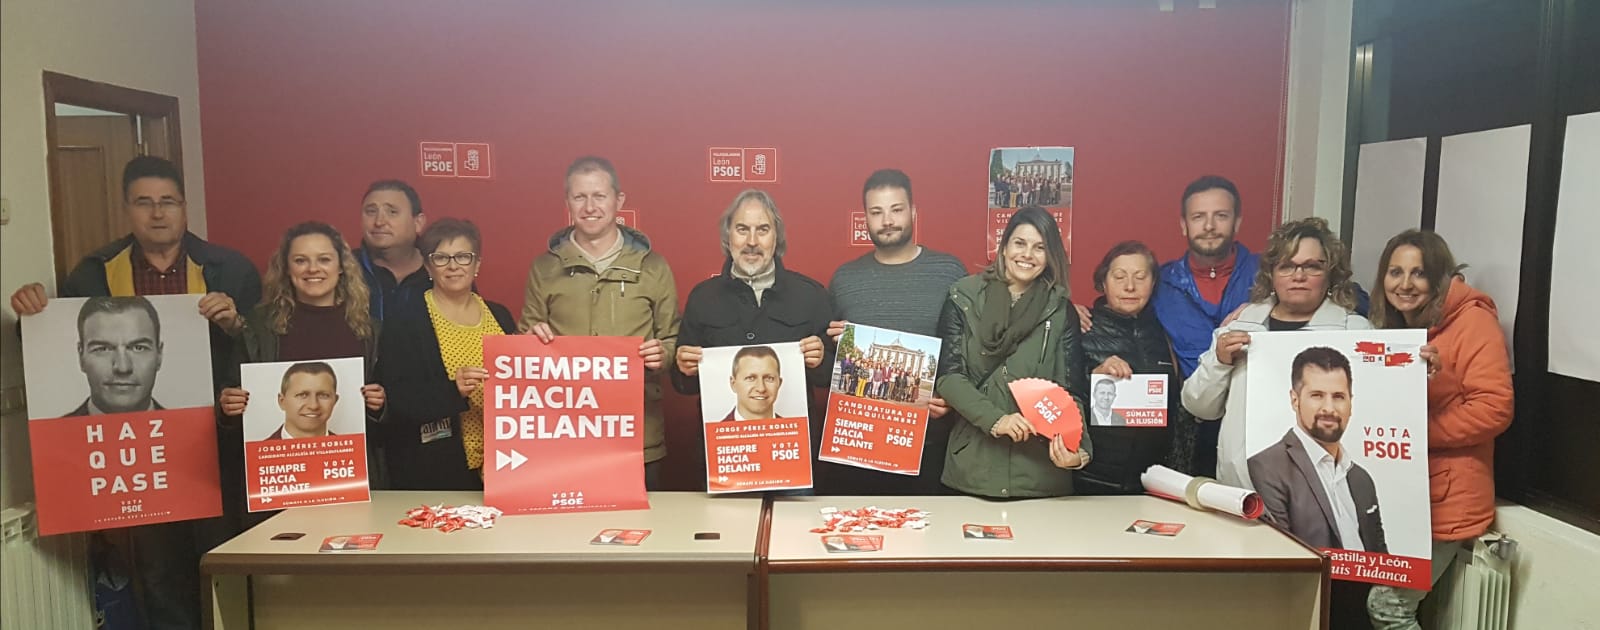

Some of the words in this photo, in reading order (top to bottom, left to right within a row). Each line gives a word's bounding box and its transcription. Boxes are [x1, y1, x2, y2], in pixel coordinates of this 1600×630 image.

[424, 161, 452, 172] PSOE
[713, 166, 740, 176] PSOE
[495, 356, 628, 380] SIEMPRE
[495, 385, 599, 408] HACIA
[838, 400, 902, 416] CANDIDATURA
[1034, 401, 1057, 424] PSOE
[1042, 396, 1062, 416] VOTA
[838, 406, 917, 425] VILLAQUILAMBRE
[495, 415, 635, 440] DELANTE
[835, 418, 874, 432] SIEMPRE
[888, 427, 914, 436] VOTA
[86, 420, 164, 444] HAZ
[834, 427, 864, 439] HACIA
[1364, 426, 1410, 438] VOTA
[832, 436, 873, 450] DELANTE
[886, 434, 914, 448] PSOE
[717, 444, 757, 455] SIEMPRE
[772, 449, 799, 460] PSOE
[1364, 440, 1412, 460] PSOE
[89, 445, 166, 470] QUE
[718, 454, 749, 464] HACIA
[259, 463, 306, 475] SIEMPRE
[324, 467, 355, 479] PSOE
[718, 463, 760, 473] DELANTE
[91, 471, 168, 496] PASE
[260, 474, 296, 485] HACIA
[260, 483, 310, 496] DELANTE
[122, 504, 142, 513] PSOE
[1369, 556, 1376, 566] y
[1380, 556, 1412, 569] León.
[1331, 564, 1350, 575] uis
[1354, 565, 1412, 583] Tudanca.
